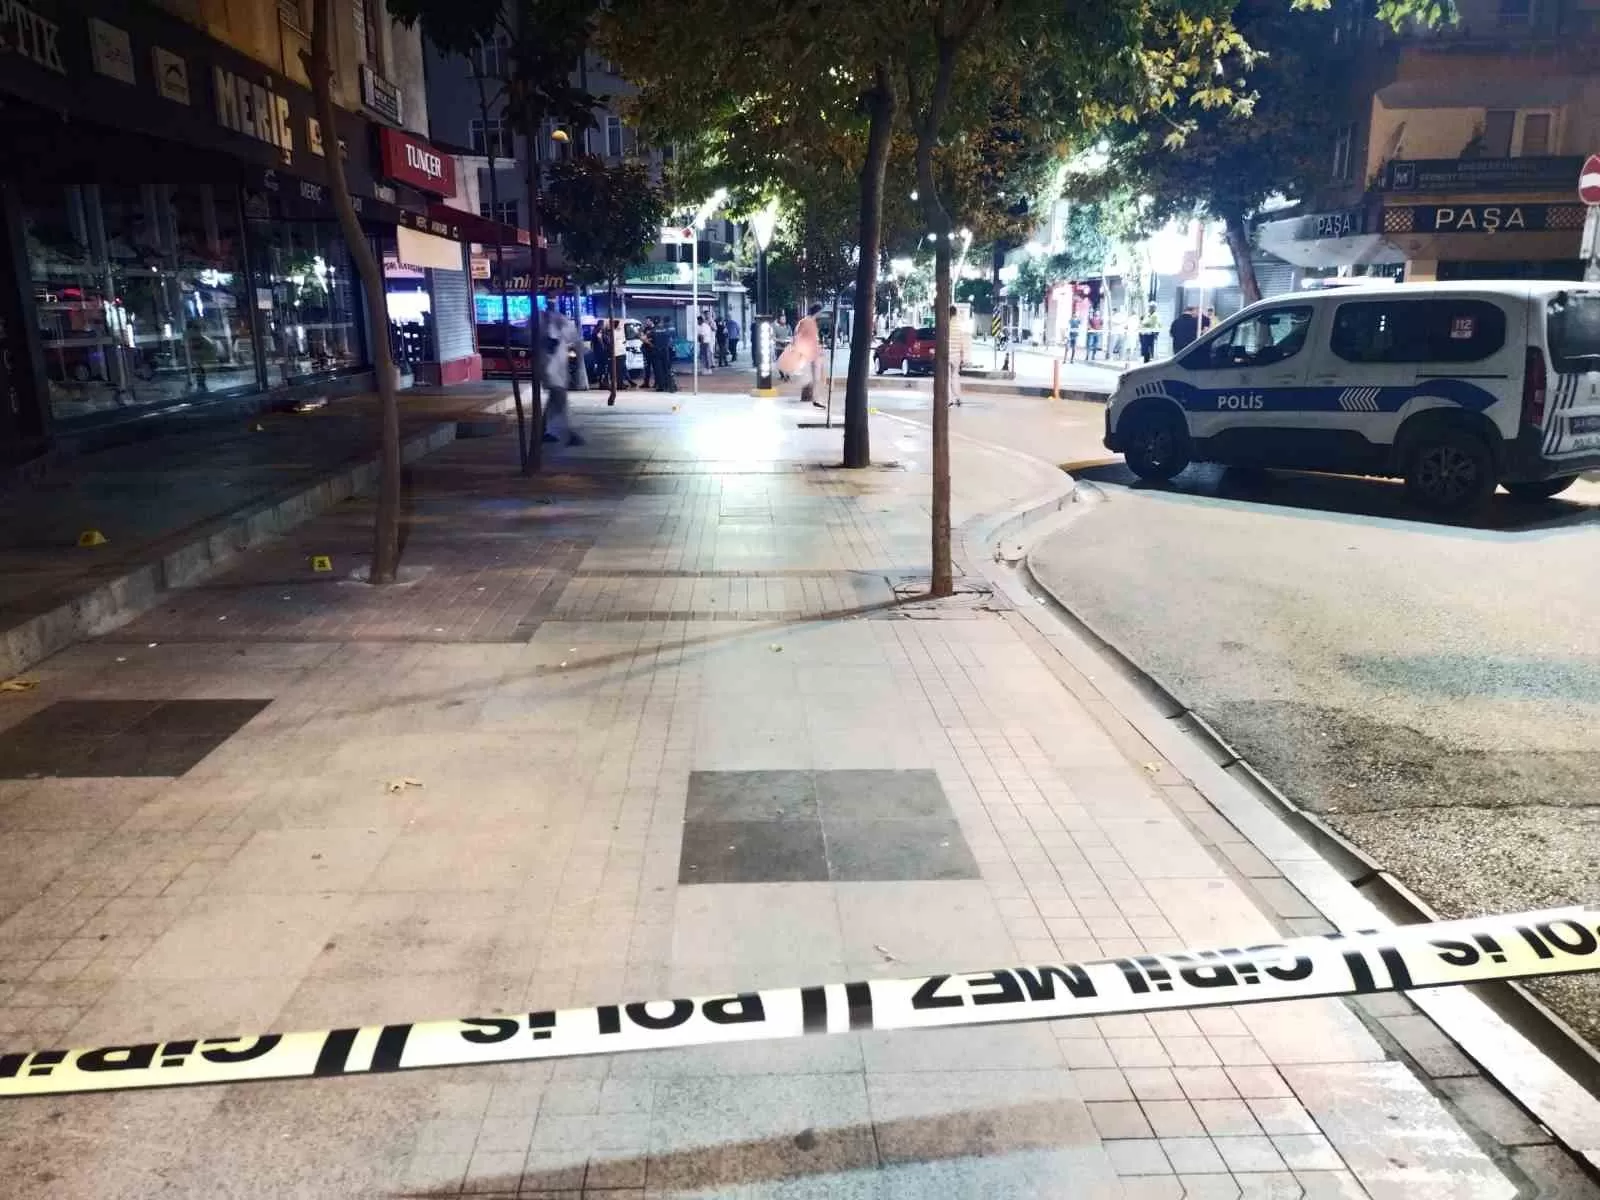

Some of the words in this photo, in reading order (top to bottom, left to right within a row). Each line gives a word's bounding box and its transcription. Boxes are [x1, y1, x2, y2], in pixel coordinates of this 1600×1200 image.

[405, 143, 442, 180] TUNÇER
[1318, 214, 1351, 238] PAŞA
[1435, 207, 1525, 234] PAŞA
[1217, 391, 1263, 410] POLİS
[1428, 919, 1600, 967] OLİS
